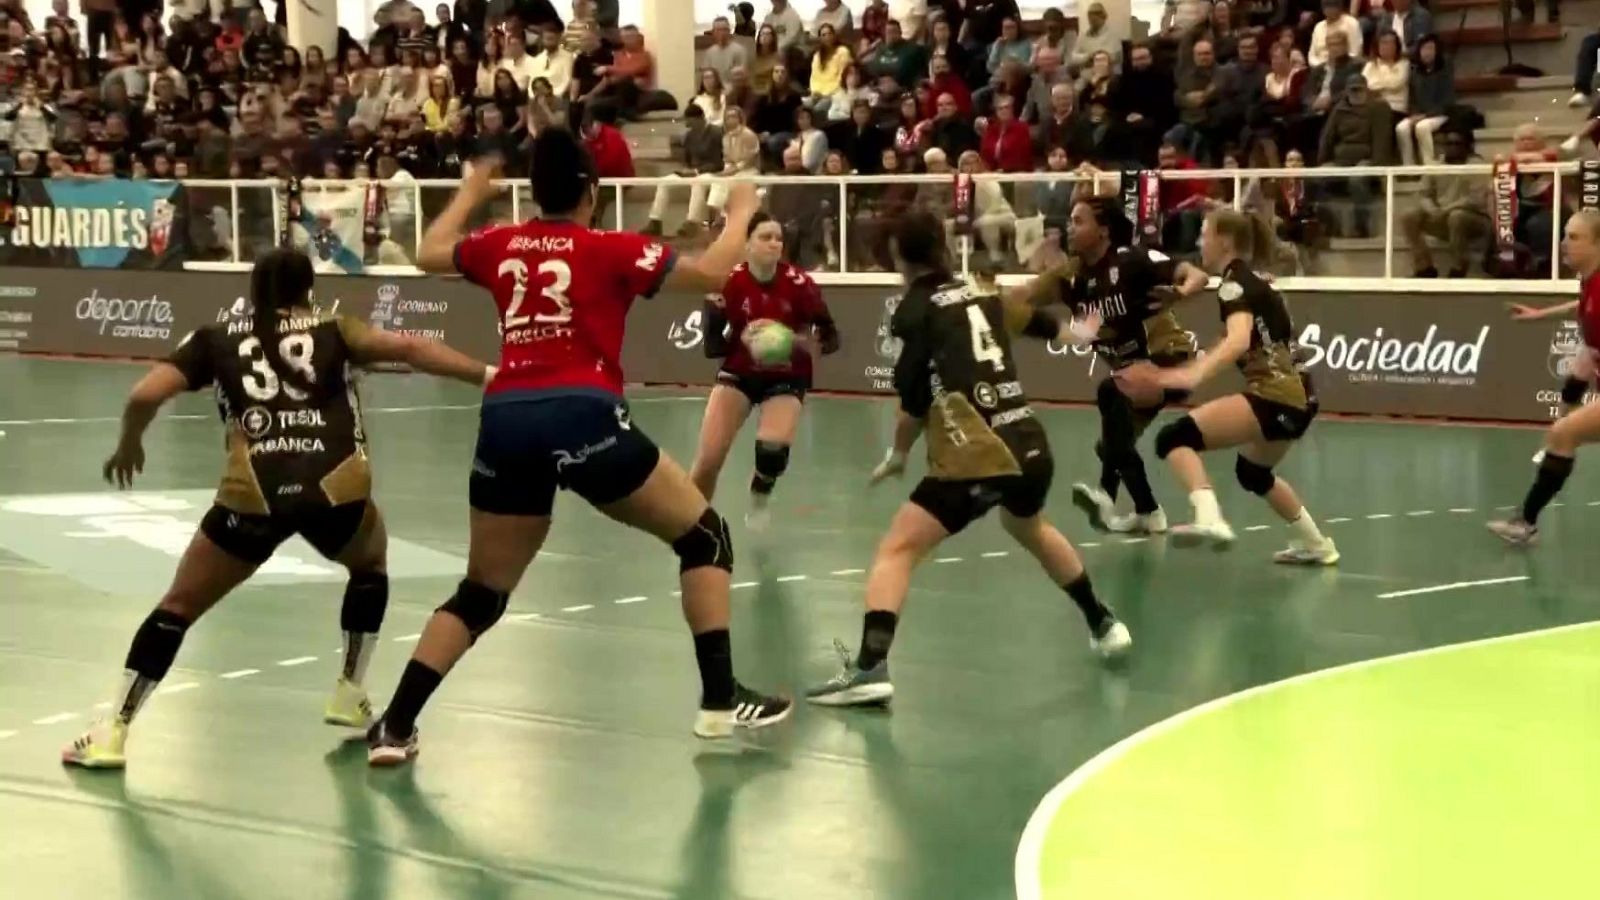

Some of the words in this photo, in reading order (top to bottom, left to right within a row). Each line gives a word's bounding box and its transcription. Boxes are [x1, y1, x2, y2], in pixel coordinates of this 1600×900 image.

[11, 200, 148, 249] GUARDÉS
[498, 258, 574, 329] 23
[966, 303, 1005, 372] 4
[1298, 323, 1490, 374] Sociedad
[238, 335, 316, 400] 38
[276, 409, 327, 429] TESOL
